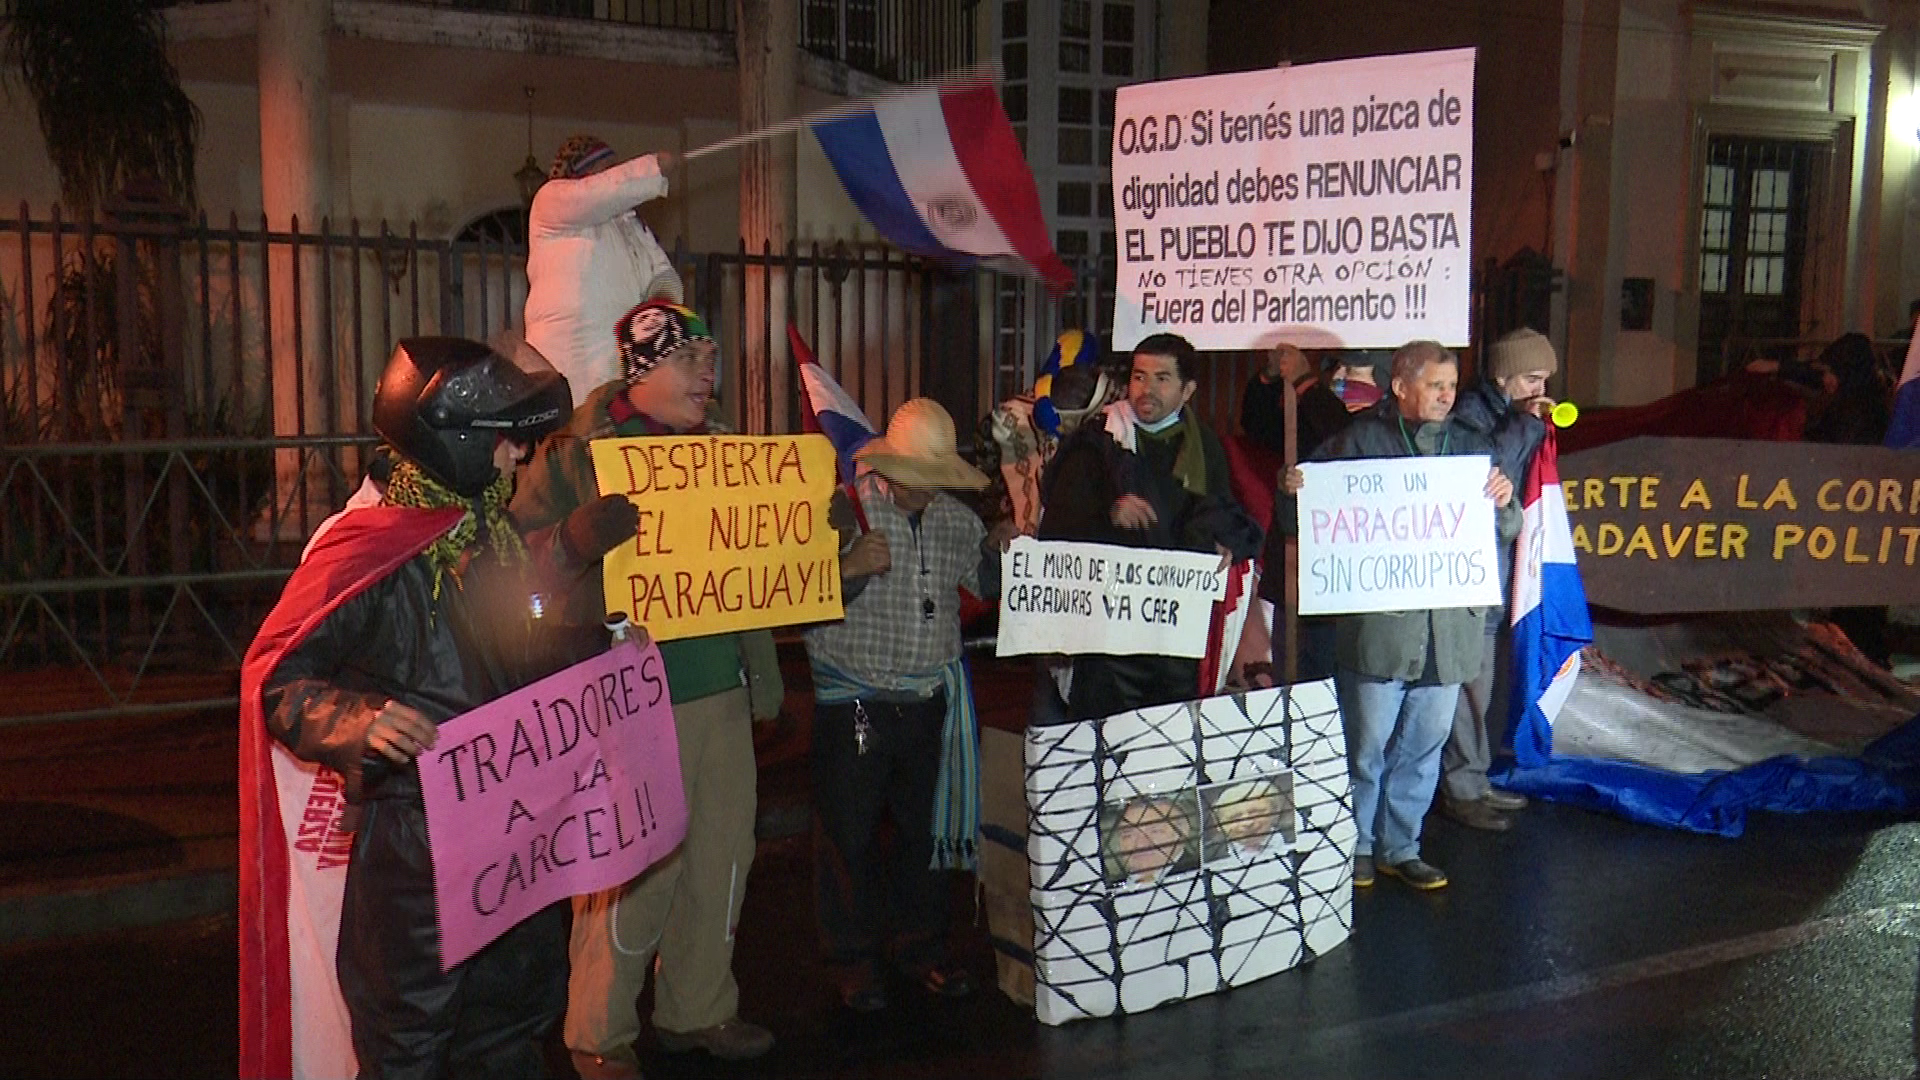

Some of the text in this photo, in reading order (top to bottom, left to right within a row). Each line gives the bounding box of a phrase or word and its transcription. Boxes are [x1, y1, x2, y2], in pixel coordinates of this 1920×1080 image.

[1191, 109, 1214, 147] Si
[1220, 101, 1292, 144] tenés
[1299, 105, 1345, 138] una
[1352, 95, 1420, 137] pizca
[1428, 88, 1462, 129] de
[1122, 153, 1462, 219] dignidad debes RENUNCIAR
[1125, 212, 1461, 262] EL PUEBLO TE DIJO BASTA
[1138, 269, 1166, 288] NO
[1263, 263, 1324, 287] OTRA
[1141, 292, 1204, 324] Fuera
[1211, 288, 1246, 324] del
[1252, 286, 1396, 323] Parlamento
[618, 437, 806, 495] DESPIERTA
[1347, 472, 1428, 494] POR UN
[1680, 478, 1712, 510] A
[1736, 473, 1798, 512] LA
[635, 500, 812, 556] EL NUEVO
[1311, 502, 1467, 544] PARAGUAY
[627, 559, 834, 622] PARAGUAY!!
[1013, 552, 1220, 592] EL MURO DE LOS CORRUPTOS
[1311, 548, 1487, 596] SIN CORRUPTOS
[1007, 583, 1180, 627] CARADURAS VA CAER
[437, 655, 663, 802] TRAIDORES
[505, 758, 612, 834] A LA
[471, 780, 657, 917] CARCEL!!
